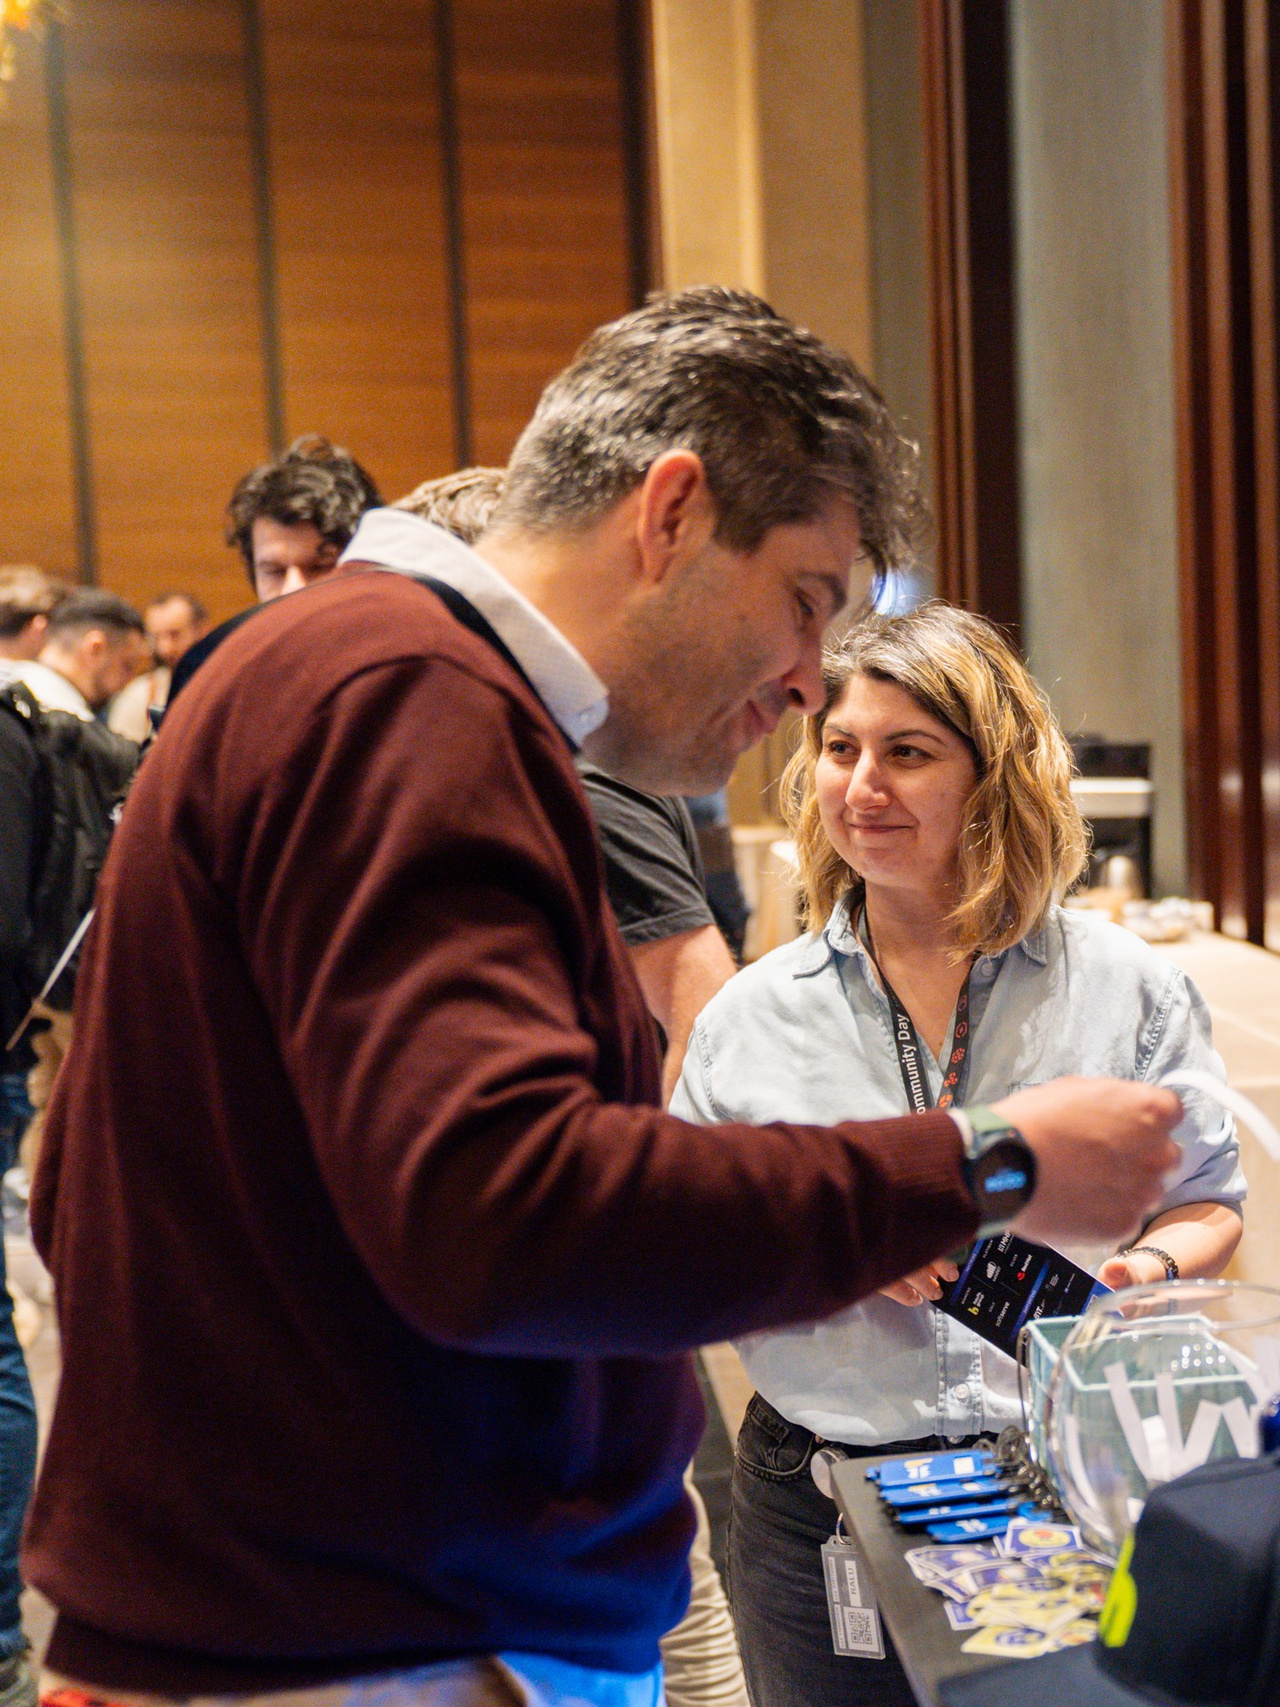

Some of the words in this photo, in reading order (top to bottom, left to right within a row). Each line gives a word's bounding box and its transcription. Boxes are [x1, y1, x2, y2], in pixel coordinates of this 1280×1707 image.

[897, 1014, 910, 1041] Day
[902, 1044, 926, 1115] ommunity
[995, 1301, 1010, 1327] softserve
[848, 1567, 857, 1595] RALU
